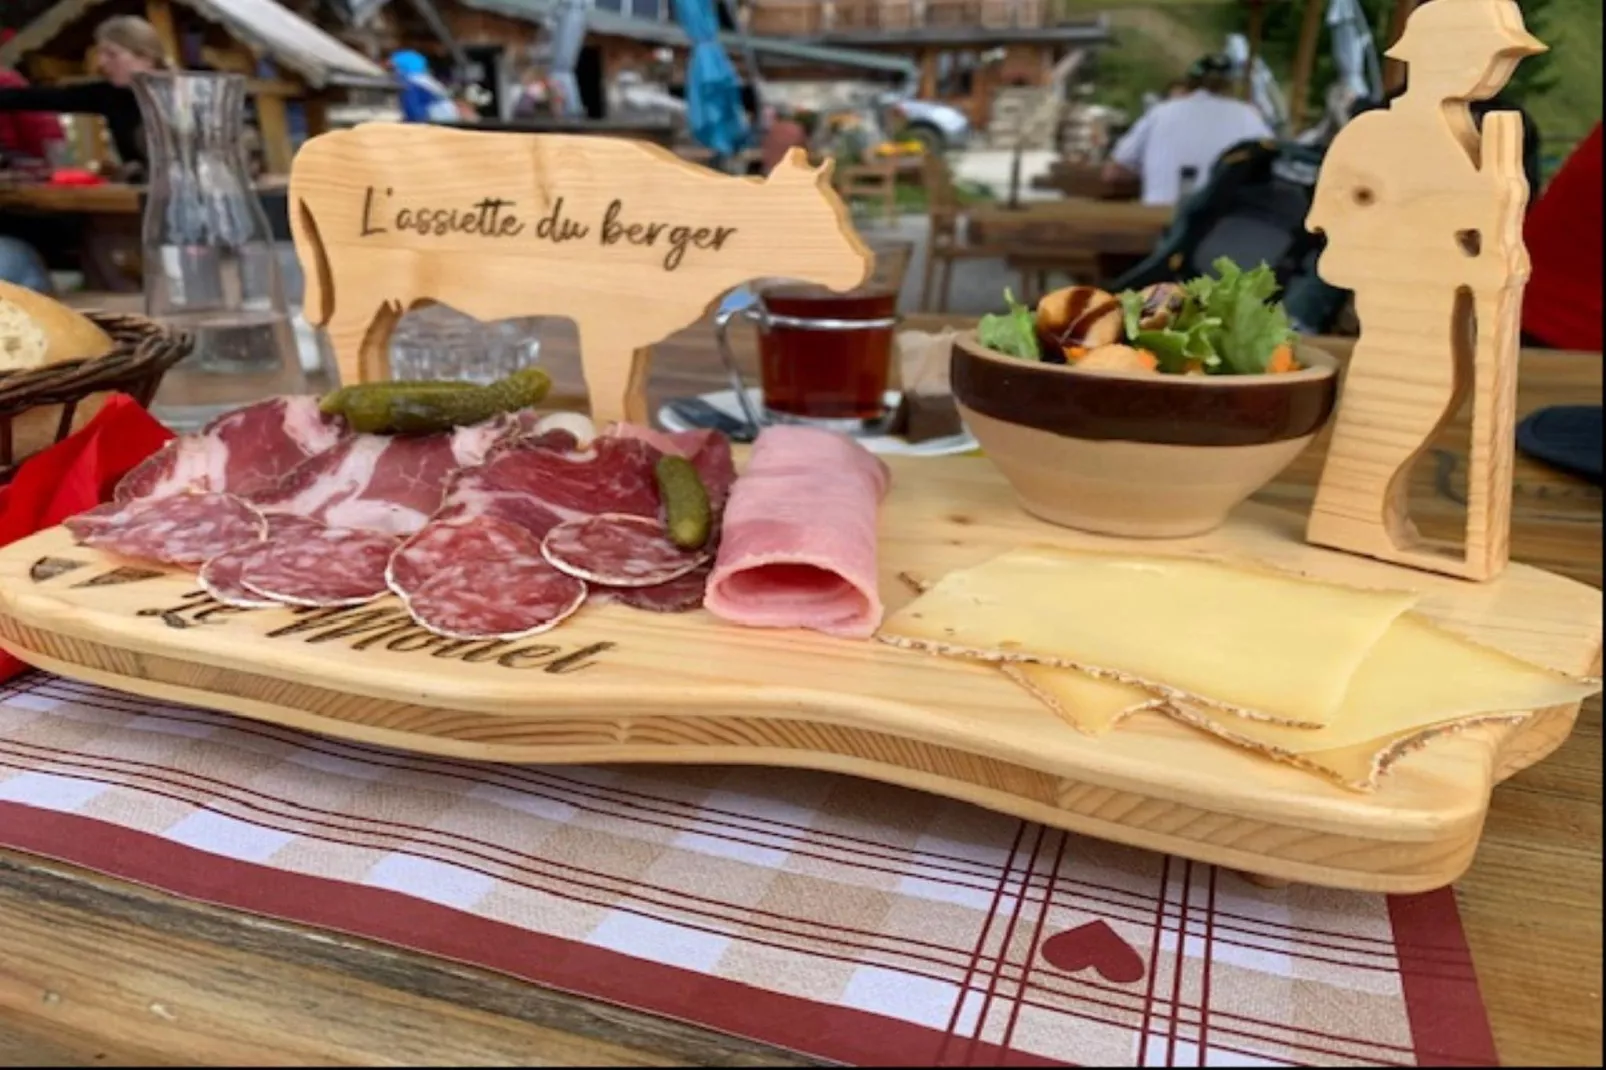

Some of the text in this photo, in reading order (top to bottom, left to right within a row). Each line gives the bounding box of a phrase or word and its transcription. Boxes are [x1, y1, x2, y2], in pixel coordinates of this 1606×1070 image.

[359, 185, 738, 272] L'assiette du berger
